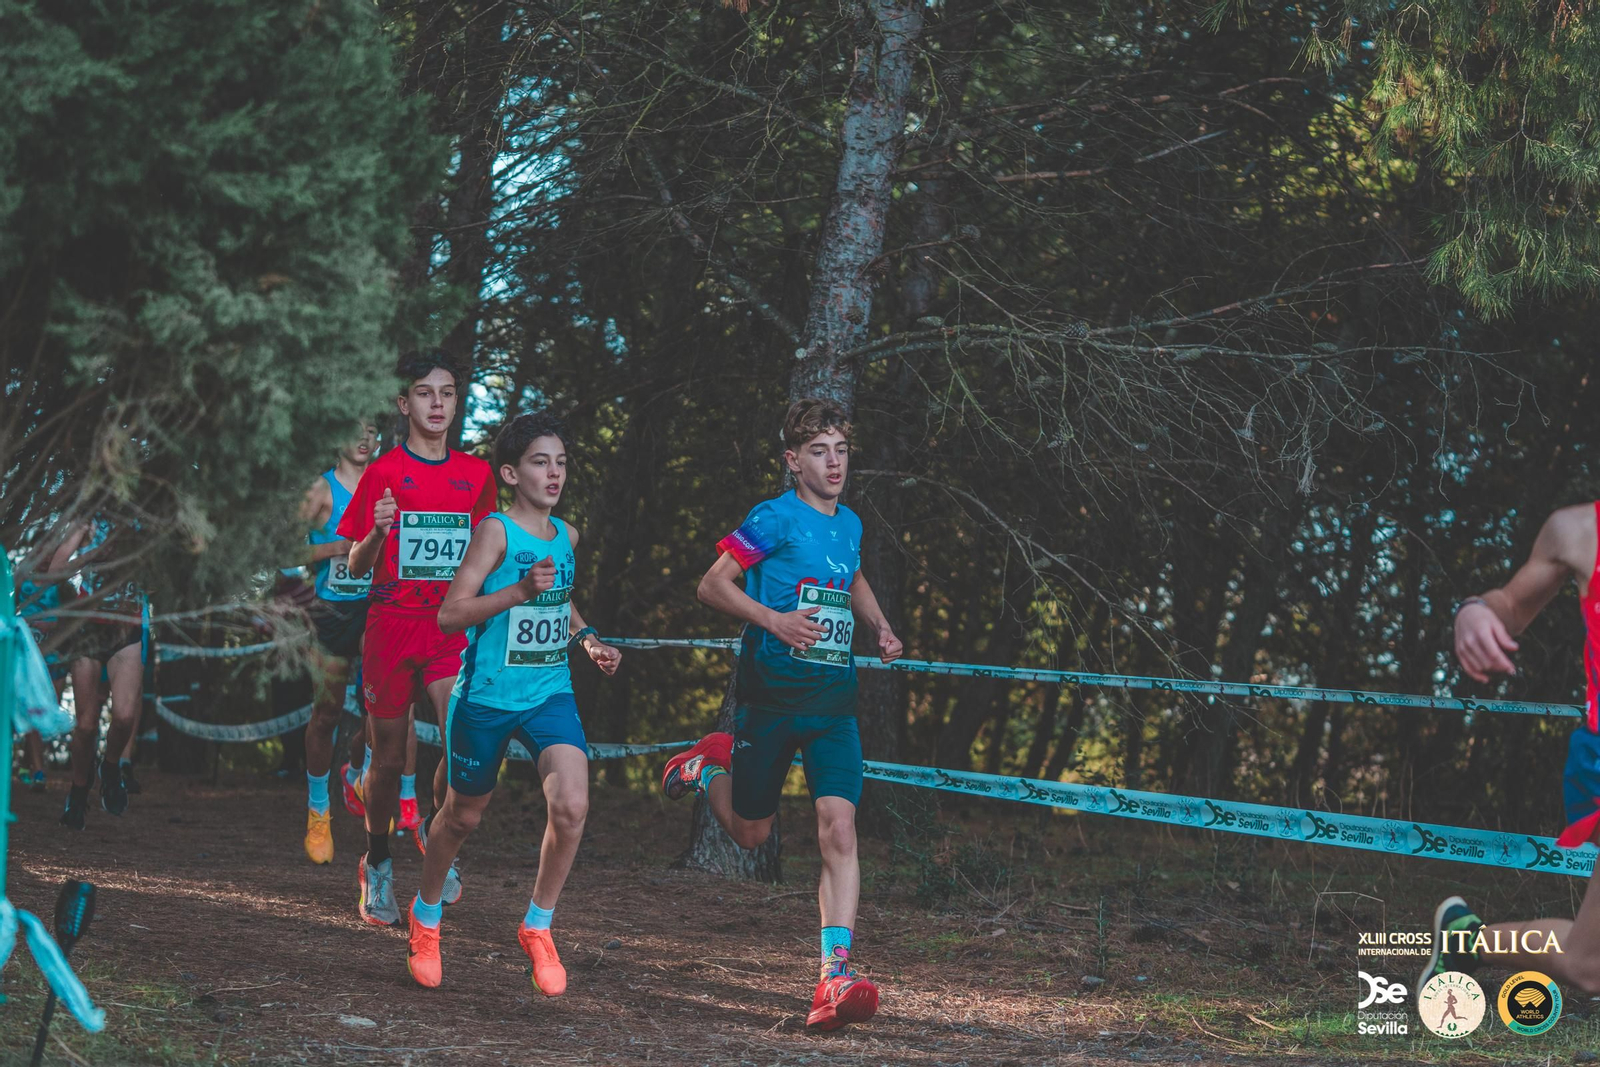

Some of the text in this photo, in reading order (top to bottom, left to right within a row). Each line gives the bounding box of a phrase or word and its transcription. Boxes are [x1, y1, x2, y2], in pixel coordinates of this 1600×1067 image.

[423, 514, 455, 524] ITÁLICA
[408, 538, 467, 561] 7947
[515, 553, 538, 564] TROPS
[516, 615, 569, 645] 8030
[452, 751, 480, 767] nerja
[1050, 793, 1080, 806] Sevilla
[1141, 805, 1172, 819] Sevilla
[1238, 817, 1270, 832] Sevilla
[1340, 830, 1375, 845] Sevilla
[1449, 844, 1486, 859] Sevilla
